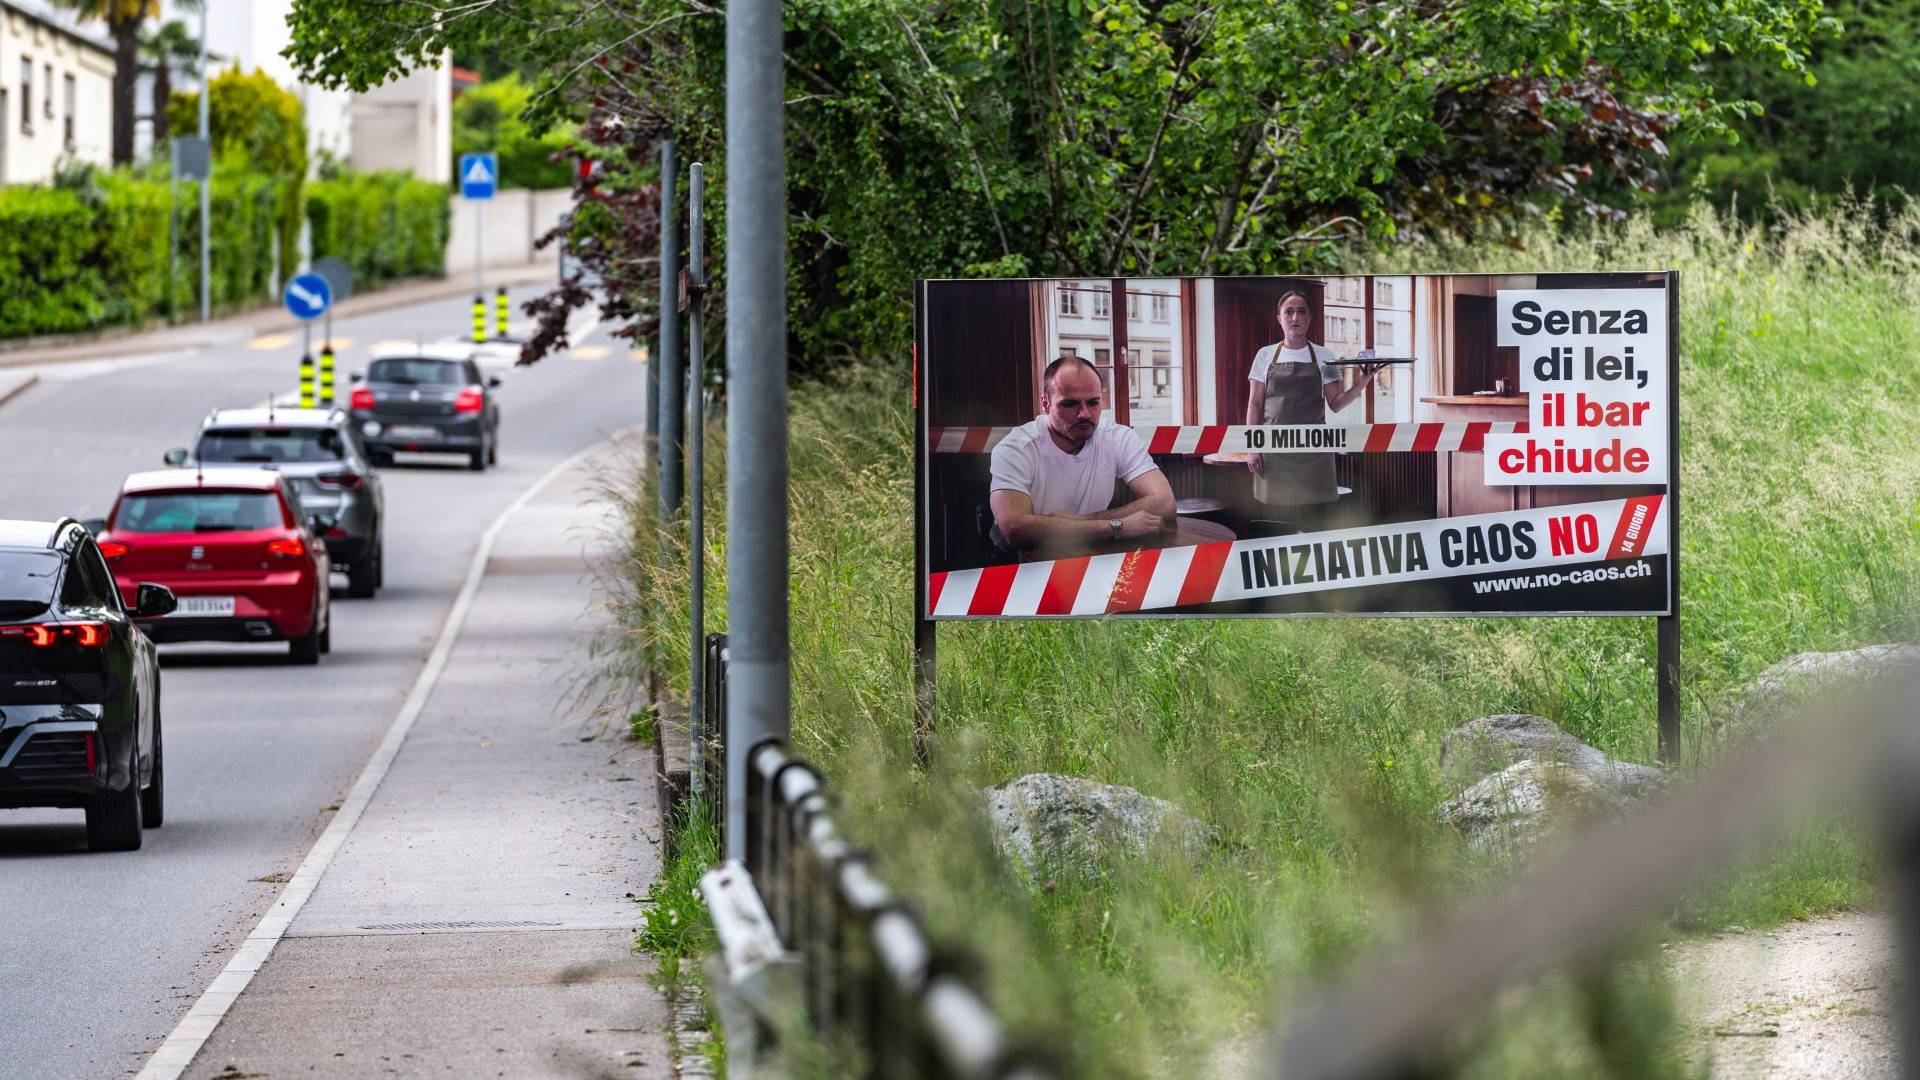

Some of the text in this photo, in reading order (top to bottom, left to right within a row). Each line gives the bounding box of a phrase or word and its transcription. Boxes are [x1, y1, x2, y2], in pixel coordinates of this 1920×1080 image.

[1512, 300, 1648, 336] Senza
[1533, 346, 1648, 389] di lei,
[1542, 392, 1650, 428] il bar
[1244, 428, 1347, 449] 10 MILIONI!
[1498, 439, 1650, 475] chiude
[1621, 504, 1648, 553] 14 GIUGNO
[1239, 513, 1600, 590] INIZIATIVA CAOS NO
[1472, 559, 1652, 594] www.no-caos.ch
